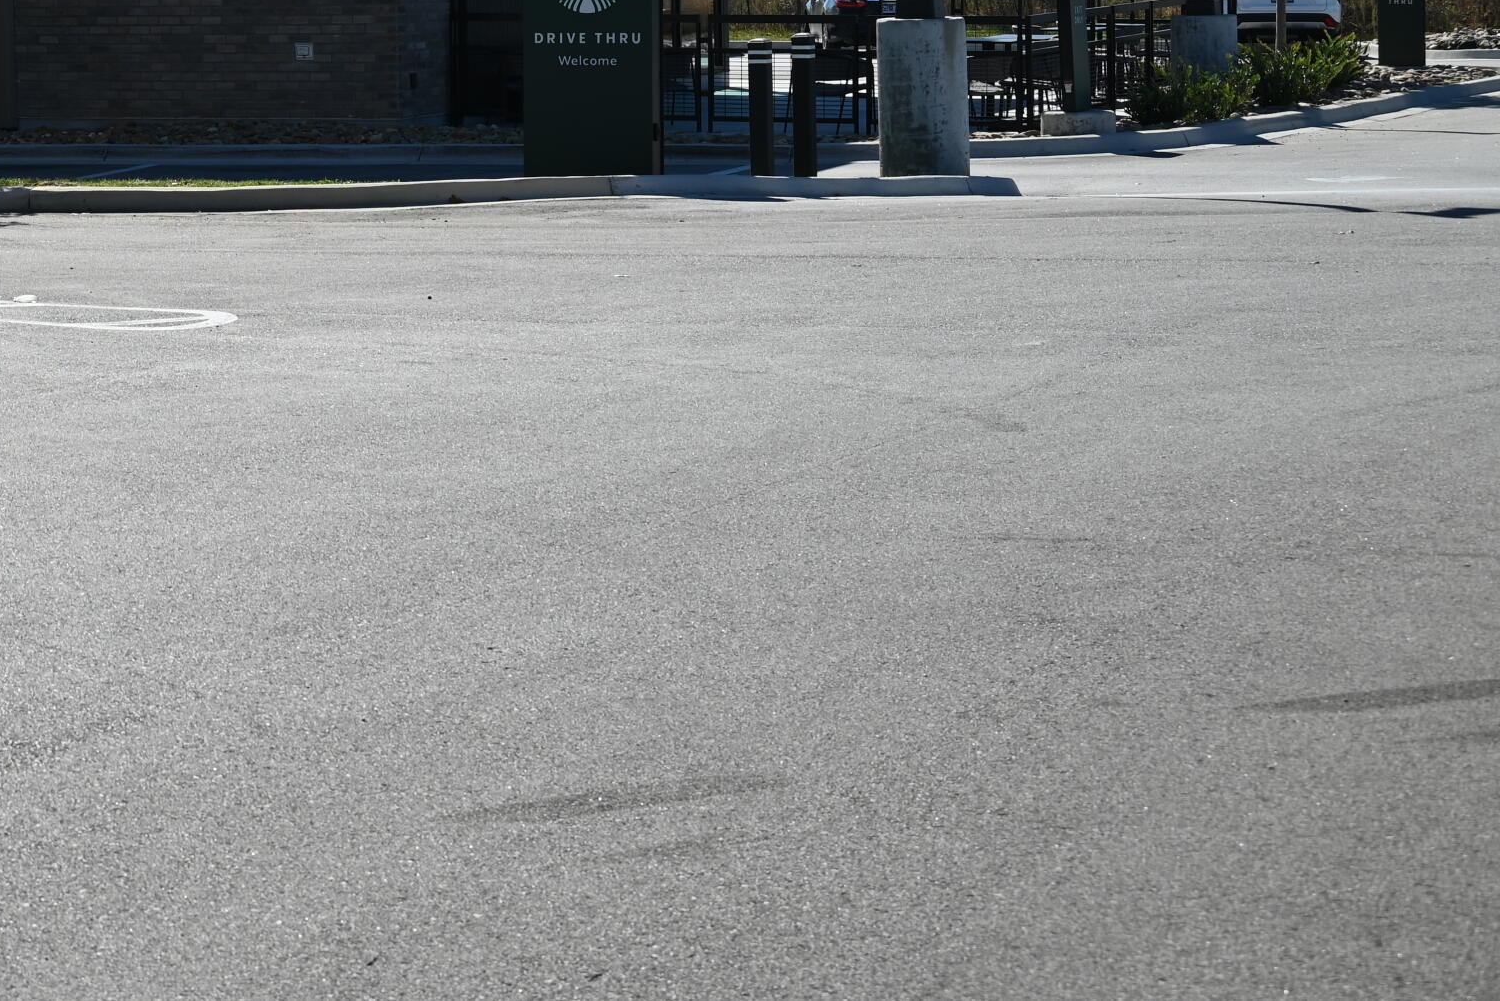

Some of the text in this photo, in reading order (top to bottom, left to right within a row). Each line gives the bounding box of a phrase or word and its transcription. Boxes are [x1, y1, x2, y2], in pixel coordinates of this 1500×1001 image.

[534, 32, 642, 44] DRIVE THRU
[558, 55, 618, 66] Welcome
